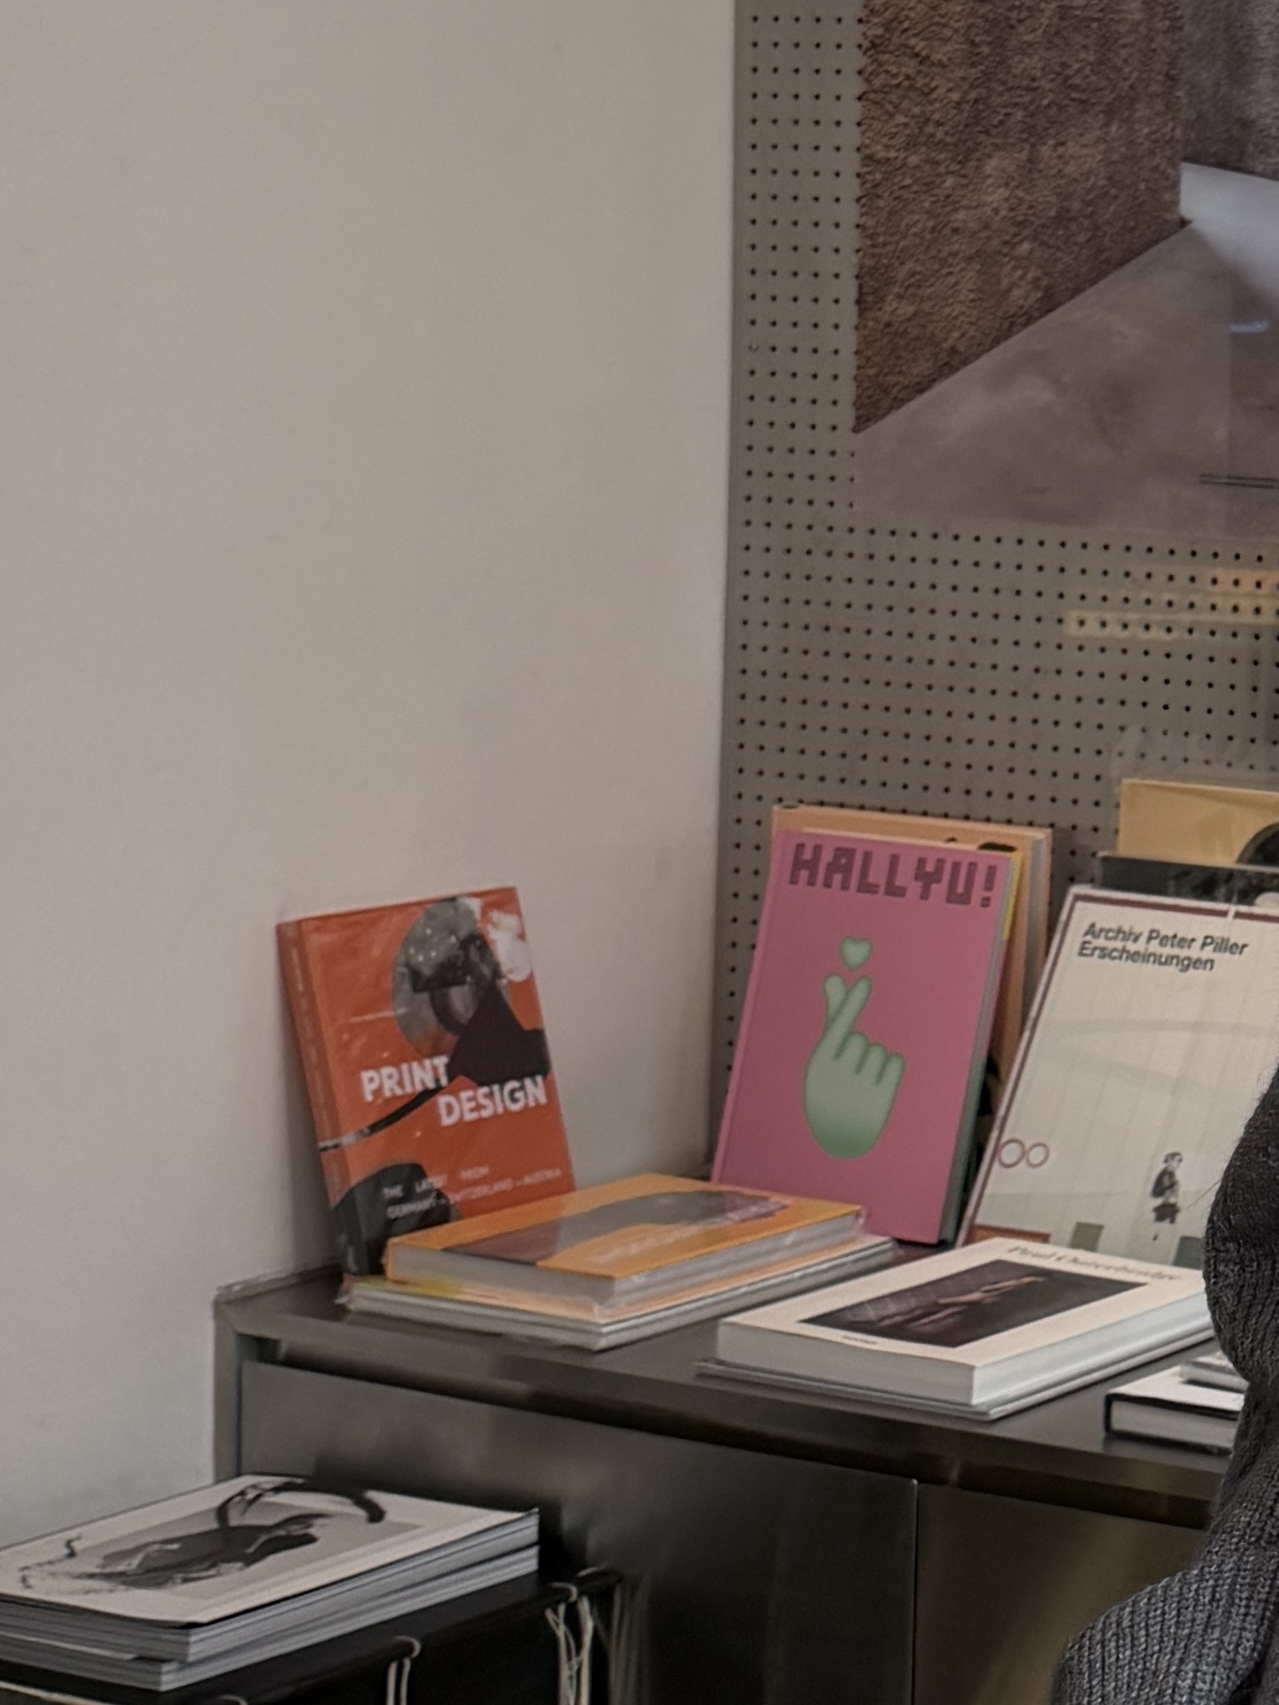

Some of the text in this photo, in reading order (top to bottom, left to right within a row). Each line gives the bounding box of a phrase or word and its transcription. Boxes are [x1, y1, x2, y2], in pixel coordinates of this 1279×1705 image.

[789, 843, 998, 908] HALLYU!
[1077, 940, 1215, 973] Erscheinungen
[1083, 922, 1248, 956] Archiv Peter Piller
[361, 1055, 451, 1102] PRINT
[437, 1075, 548, 1127] DESIGN
